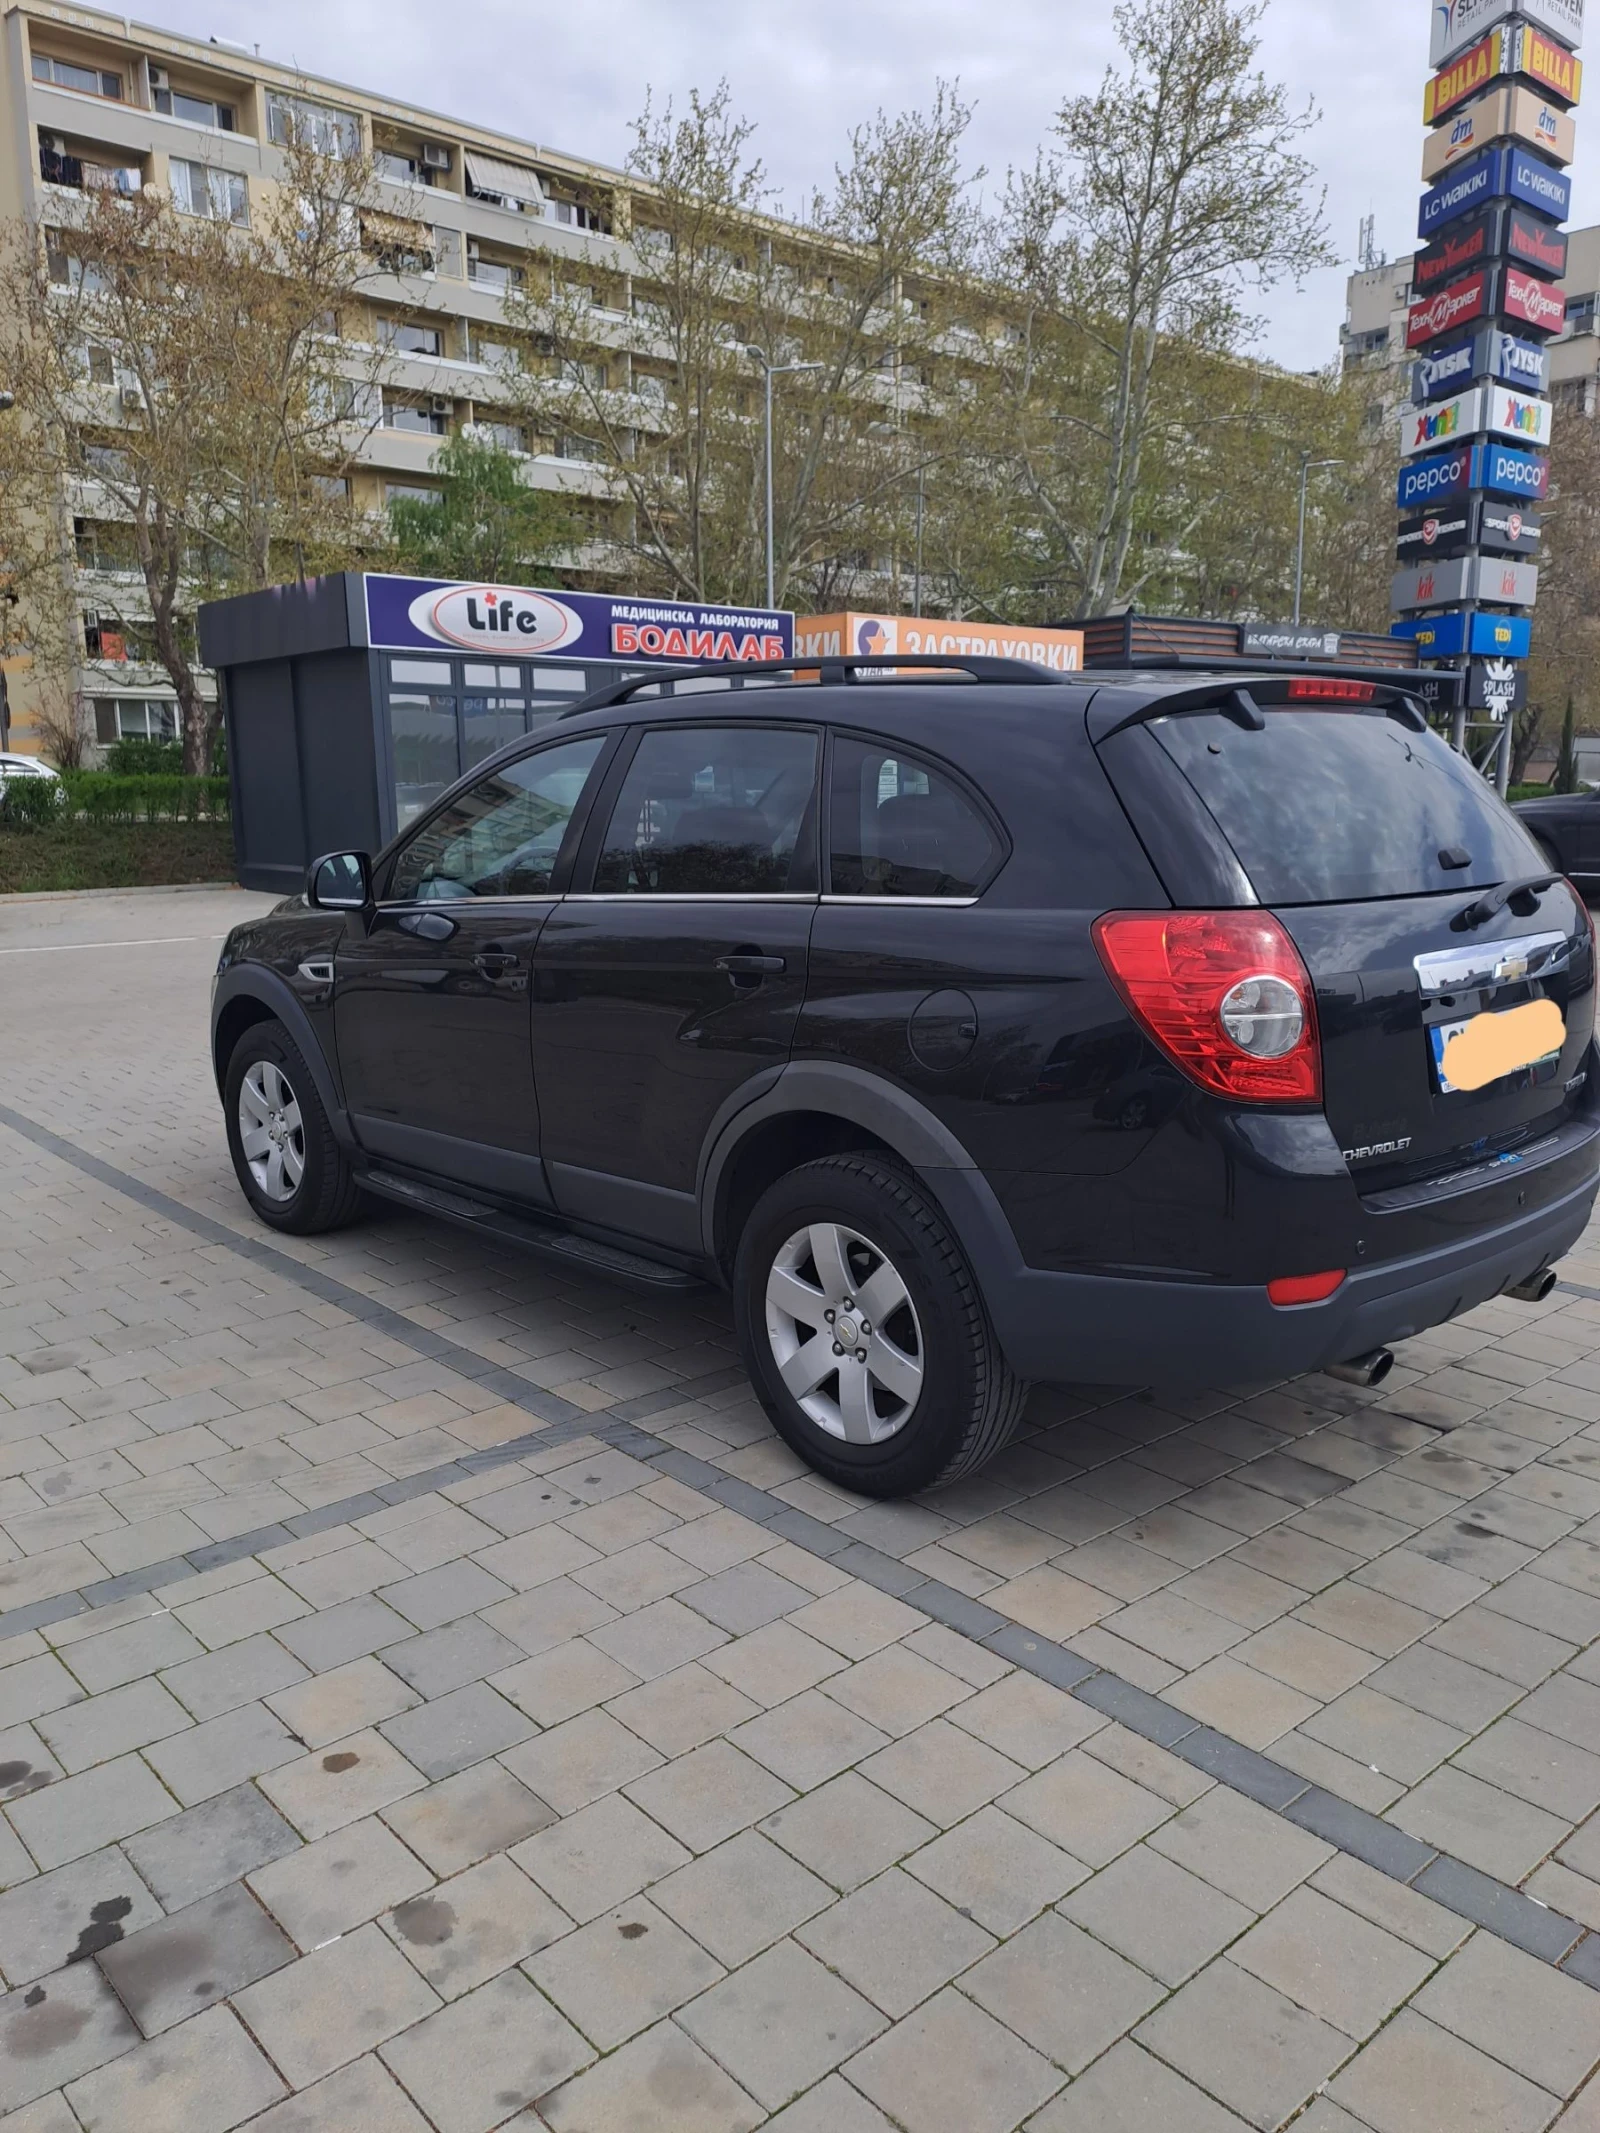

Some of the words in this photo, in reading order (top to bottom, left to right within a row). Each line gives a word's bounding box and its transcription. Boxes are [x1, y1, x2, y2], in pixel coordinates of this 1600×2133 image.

[1437, 50, 1487, 108] BILLA
[1533, 41, 1571, 91] BILLA
[1451, 118, 1473, 144] dm
[1539, 107, 1556, 133] dm
[1517, 165, 1530, 187] LC
[1425, 199, 1440, 220] LC
[1428, 347, 1472, 383] JYSK
[1511, 346, 1544, 377] JYSK
[1405, 461, 1461, 499] pepco
[1496, 457, 1542, 487] pepco
[1416, 571, 1435, 600] kik
[1502, 569, 1516, 597] kik
[467, 592, 537, 634] Life
[611, 605, 694, 624] МЕДИЦИНСКА
[700, 612, 779, 631] ЛАБОРАТОРИЯ
[612, 622, 785, 662] БОДИЛАБ
[1483, 680, 1515, 696] SPLASH
[1342, 1137, 1412, 1161] CHEVROLET
